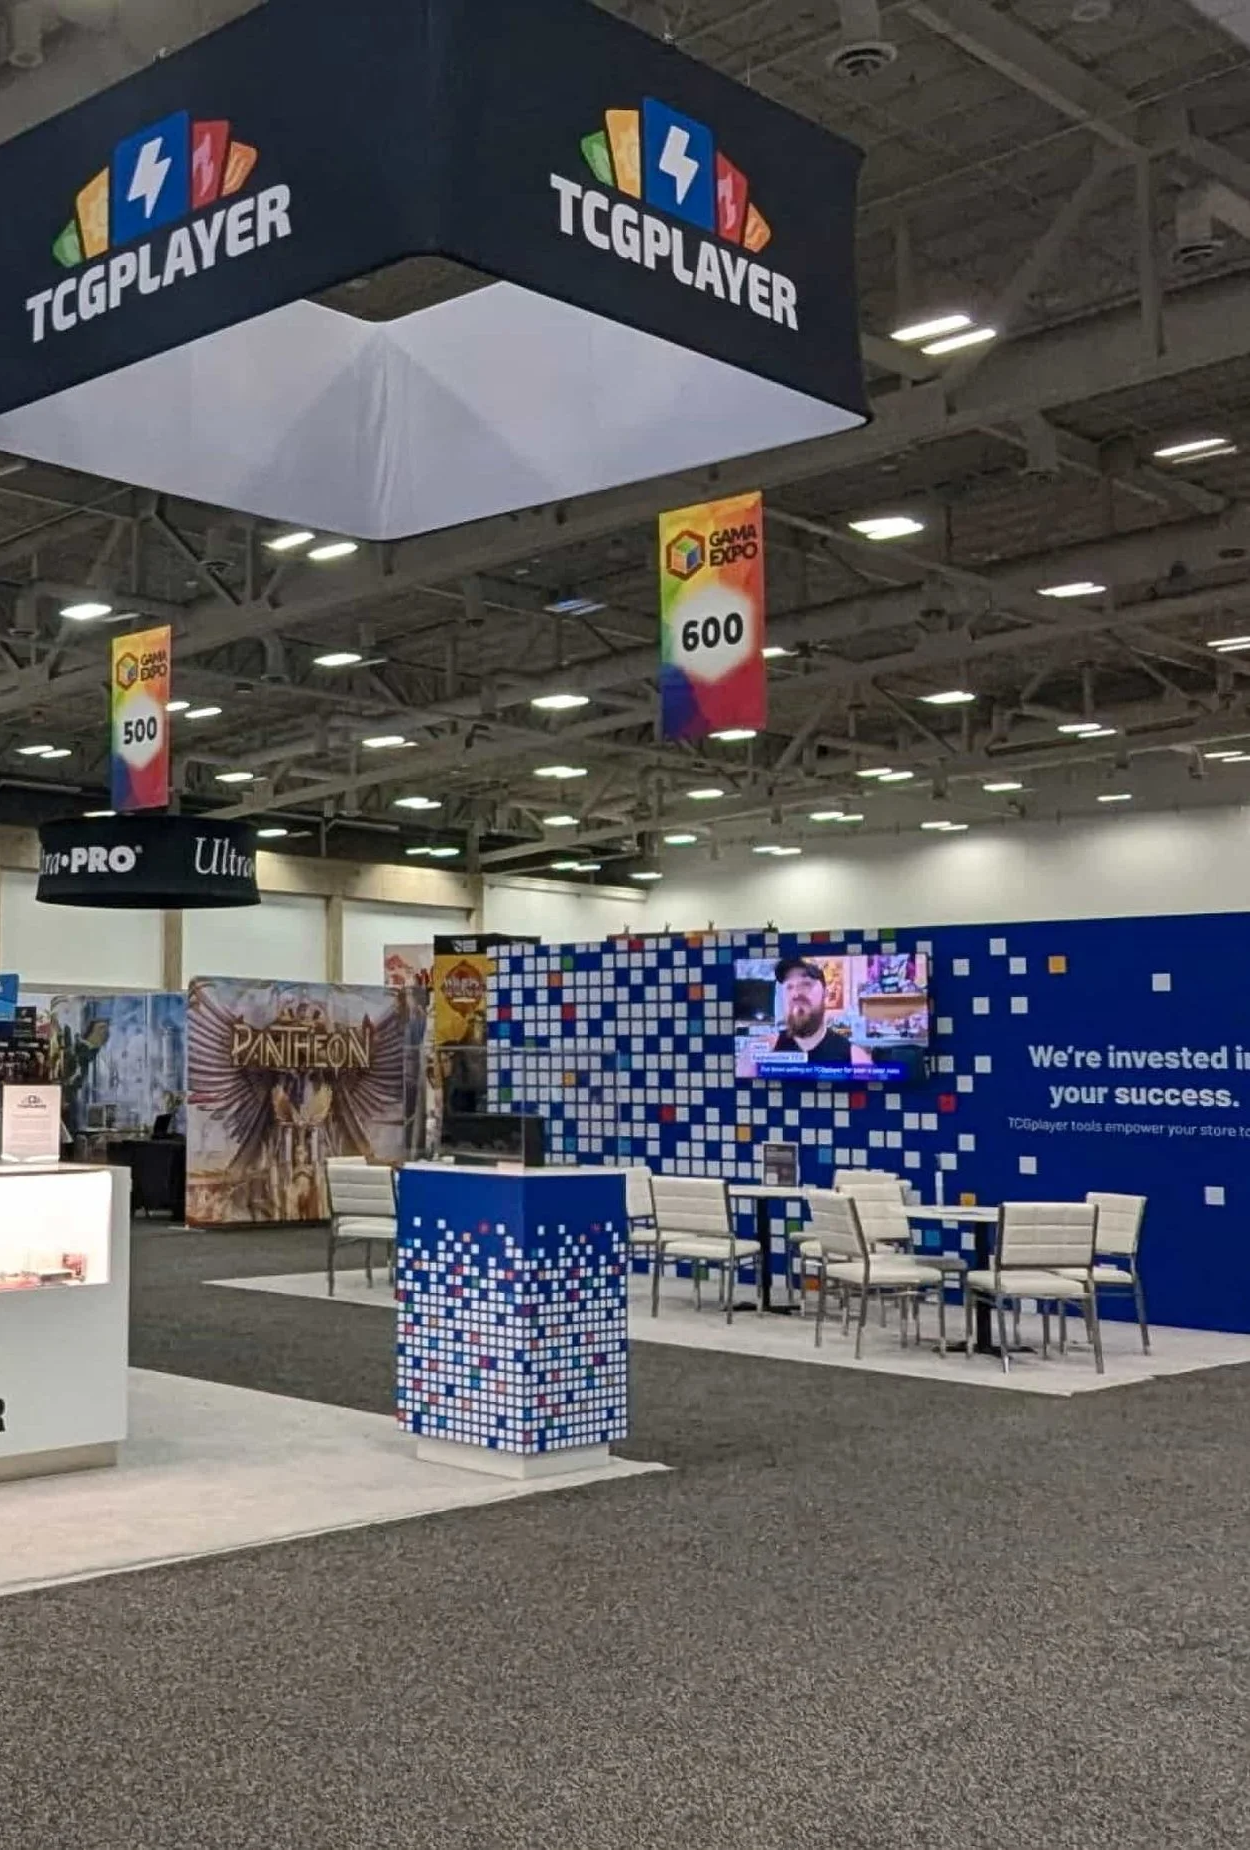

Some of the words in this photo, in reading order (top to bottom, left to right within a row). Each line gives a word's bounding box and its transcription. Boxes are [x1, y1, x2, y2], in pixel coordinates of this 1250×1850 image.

[26, 184, 291, 343] TCGPLAYER
[550, 173, 798, 331] TCGPLAYER
[709, 524, 757, 547] GAMA
[709, 541, 757, 567] EXPO
[682, 612, 743, 651] 600
[124, 716, 157, 744] 500
[231, 1022, 370, 1074] PANTHEON
[1108, 1045, 1229, 1070] invested
[1049, 1086, 1109, 1109] your
[1114, 1086, 1240, 1108] success.
[1008, 1116, 1069, 1134] TCGplayer
[1070, 1120, 1103, 1133] tools
[1104, 1121, 1164, 1137] empower
[1167, 1124, 1197, 1138] your
[1199, 1125, 1236, 1138] store
